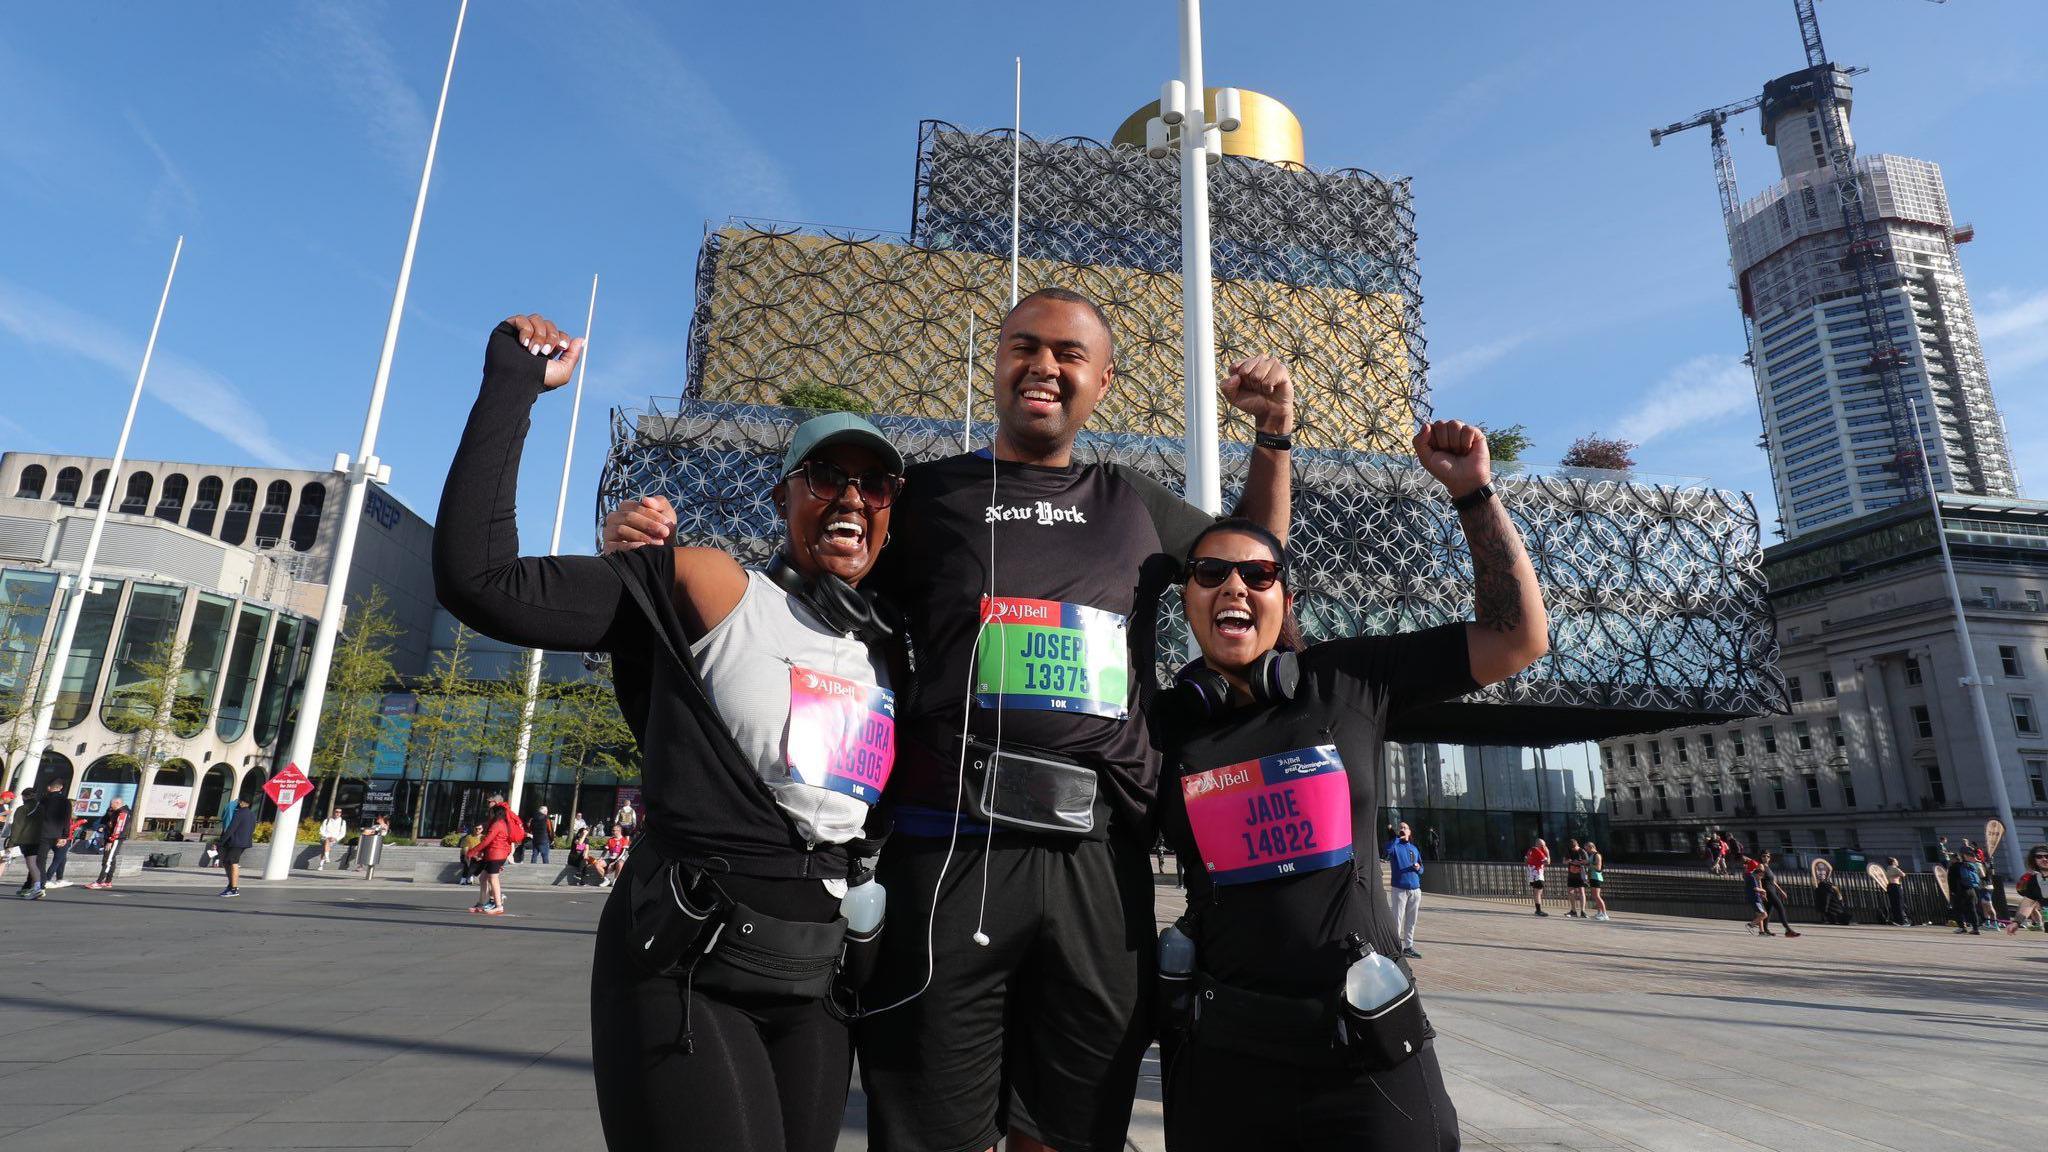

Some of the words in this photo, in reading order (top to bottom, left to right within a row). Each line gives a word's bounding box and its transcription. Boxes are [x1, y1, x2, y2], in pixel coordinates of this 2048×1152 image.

[371, 493, 401, 530] REP
[984, 504, 1032, 524] New
[1034, 501, 1087, 526] York
[1008, 603, 1048, 619] AJBell
[819, 679, 855, 697] AJBell
[1050, 699, 1067, 709] 10K
[852, 784, 865, 796] 10K
[1211, 769, 1251, 791] AJBell
[1246, 789, 1300, 826] JADE
[1242, 820, 1317, 861] 14822
[1277, 862, 1296, 874] 10K
